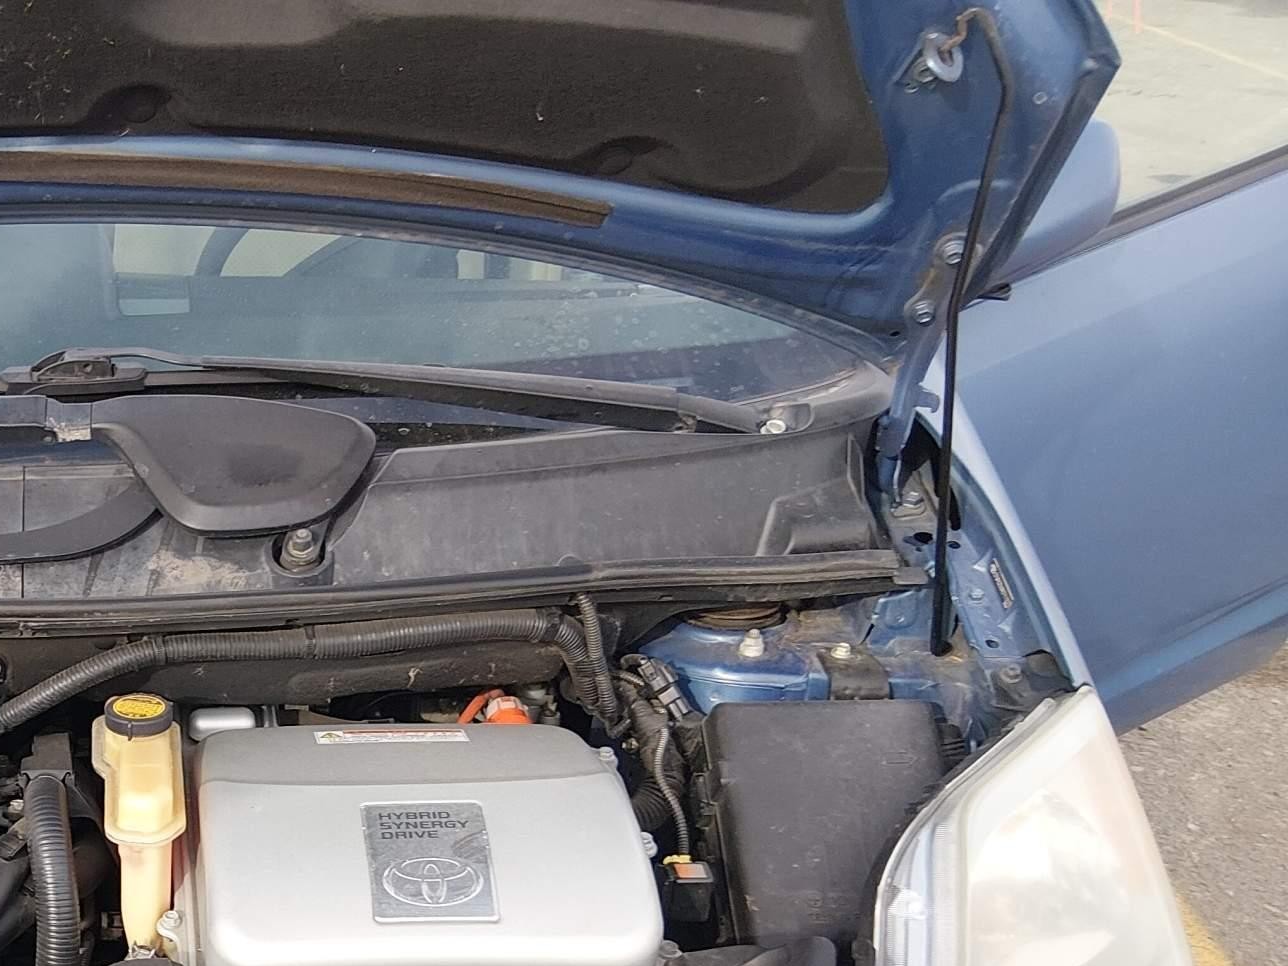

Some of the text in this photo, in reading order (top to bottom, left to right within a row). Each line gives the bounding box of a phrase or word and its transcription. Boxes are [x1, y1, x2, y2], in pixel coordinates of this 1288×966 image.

[378, 811, 450, 820] HYBRID
[379, 820, 469, 830] SYNERGY
[381, 830, 440, 839] DRIVE
